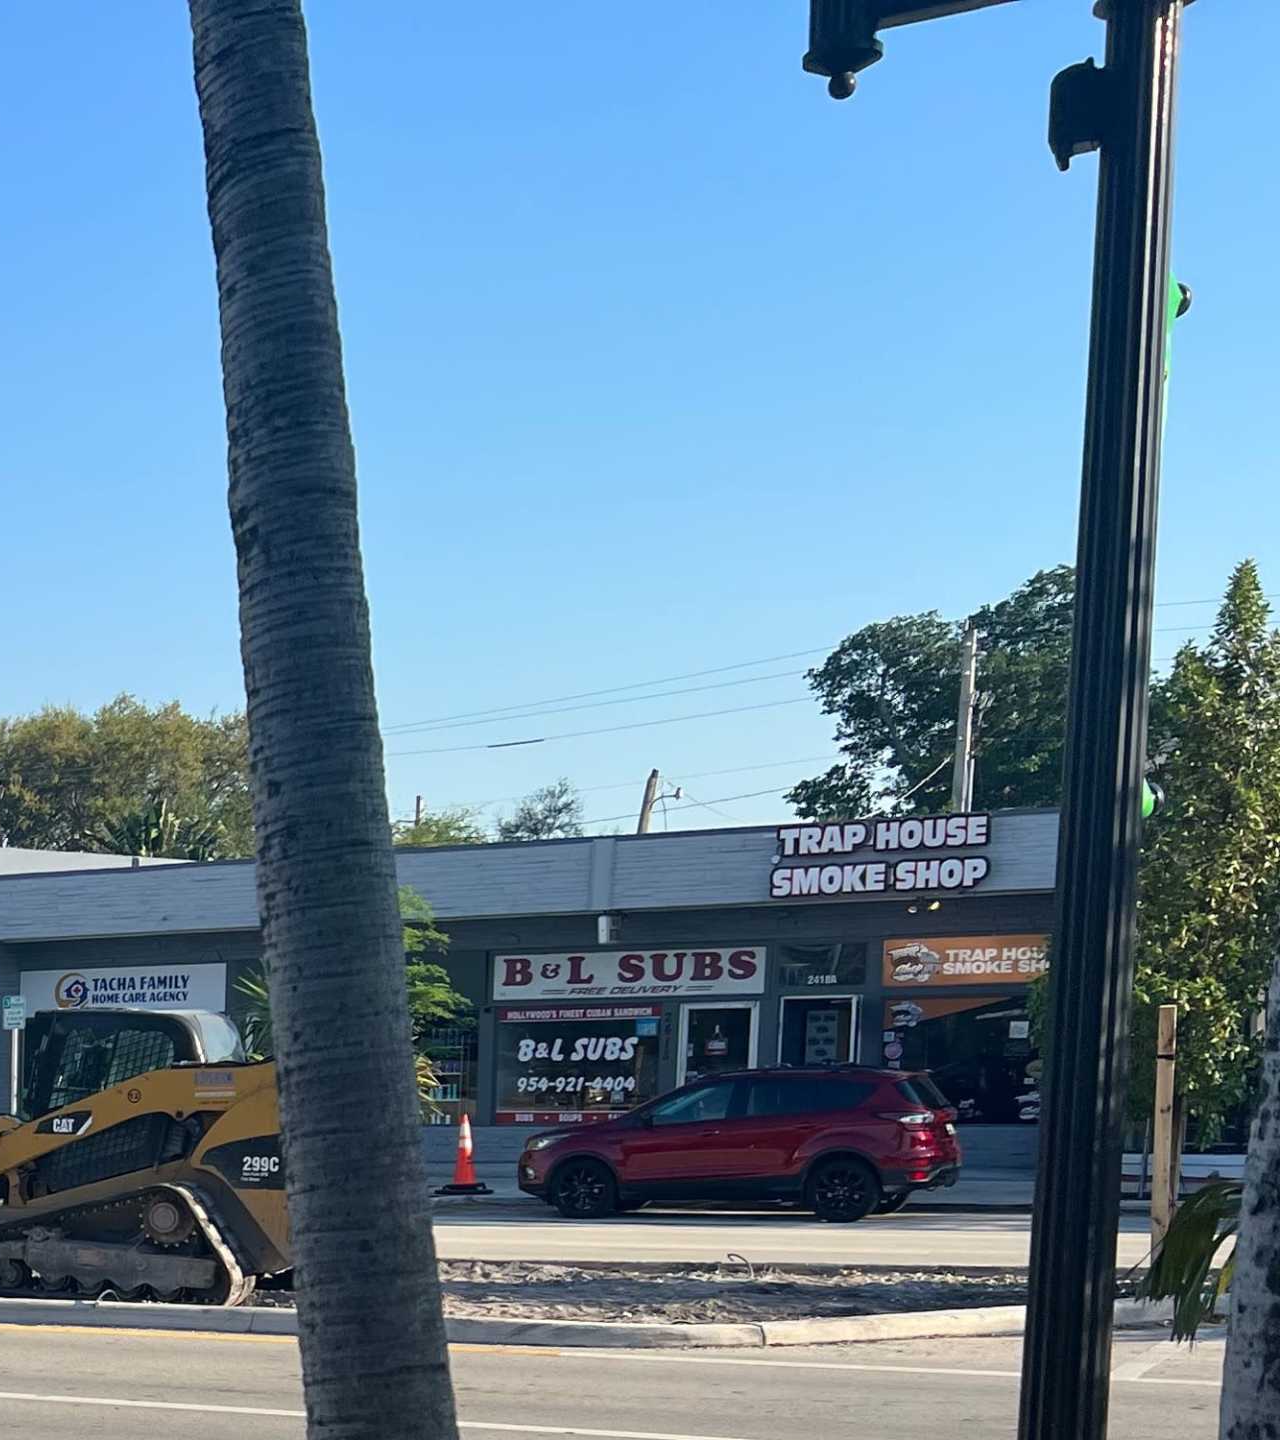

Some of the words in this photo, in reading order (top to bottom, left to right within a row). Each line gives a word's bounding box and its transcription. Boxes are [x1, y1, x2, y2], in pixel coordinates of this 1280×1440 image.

[778, 823, 867, 856] TRAP
[875, 815, 989, 851] HOUSE
[771, 863, 887, 898] SMOKE
[894, 858, 988, 891] SHOP
[945, 948, 998, 962] TRAP
[1002, 946, 1046, 960] HOU
[617, 950, 758, 984] SUBS
[942, 960, 1014, 975] SMOKE
[1017, 959, 1051, 973] SH
[91, 976, 136, 992] TACHA
[140, 975, 191, 991] FAMILY
[567, 986, 607, 996] FREE
[609, 984, 684, 996] DELIVERY
[91, 993, 120, 1005] HOME
[121, 992, 149, 1004] CARE
[150, 991, 189, 1003] AGENCY
[506, 1010, 557, 1020] HOLLYWOOD'S
[558, 1009, 585, 1019] FINEST
[586, 1008, 612, 1018] CUBAN
[613, 1007, 653, 1017] SANDWICH
[570, 1036, 639, 1062] SUBS
[516, 1076, 636, 1093] 954-921-4404
[51, 1117, 75, 1133] CAT
[242, 1155, 280, 1173] 299C
